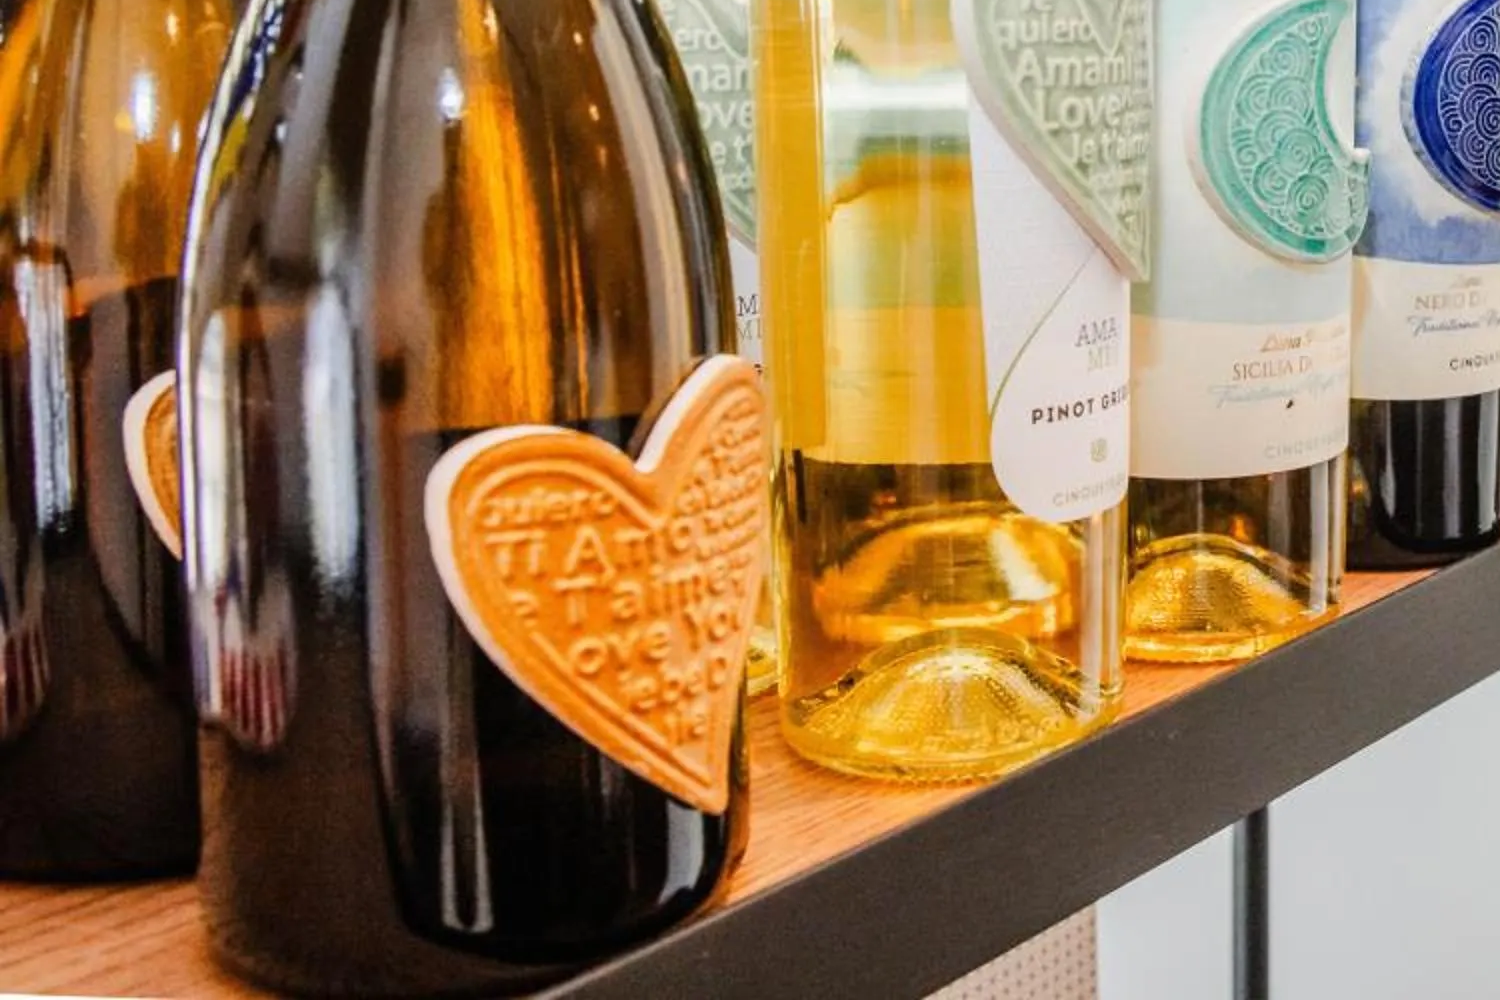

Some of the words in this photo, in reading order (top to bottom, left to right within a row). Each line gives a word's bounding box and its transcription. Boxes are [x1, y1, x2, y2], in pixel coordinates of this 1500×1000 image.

[994, 14, 1093, 51] quiero
[700, 100, 753, 131] ove
[1034, 88, 1122, 131] Love
[1231, 358, 1294, 382] SICILIA
[1031, 396, 1095, 425] PINOT
[568, 620, 671, 675] ove
